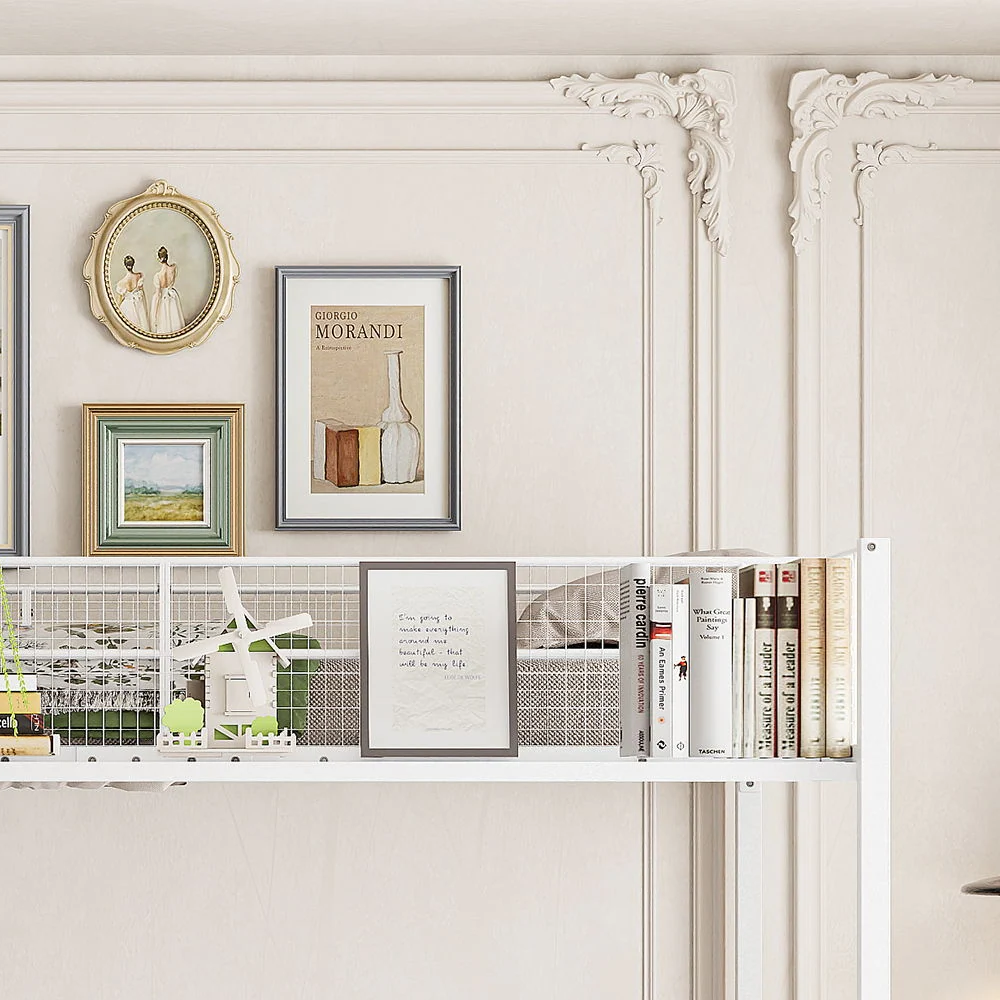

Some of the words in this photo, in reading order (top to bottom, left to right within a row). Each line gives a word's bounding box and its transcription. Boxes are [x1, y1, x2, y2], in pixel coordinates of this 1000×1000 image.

[315, 312, 358, 320] GIORGIO
[316, 324, 402, 338] MORANDI
[634, 578, 648, 610] pierre
[426, 625, 469, 635] everything
[636, 613, 648, 648] cardin
[706, 624, 719, 632] Say
[399, 648, 435, 658] beautiful
[658, 647, 666, 657] An
[452, 660, 466, 670] life
[759, 642, 772, 680] Leader
[782, 642, 796, 680] Leader
[759, 690, 772, 703] of
[782, 690, 796, 703] of
